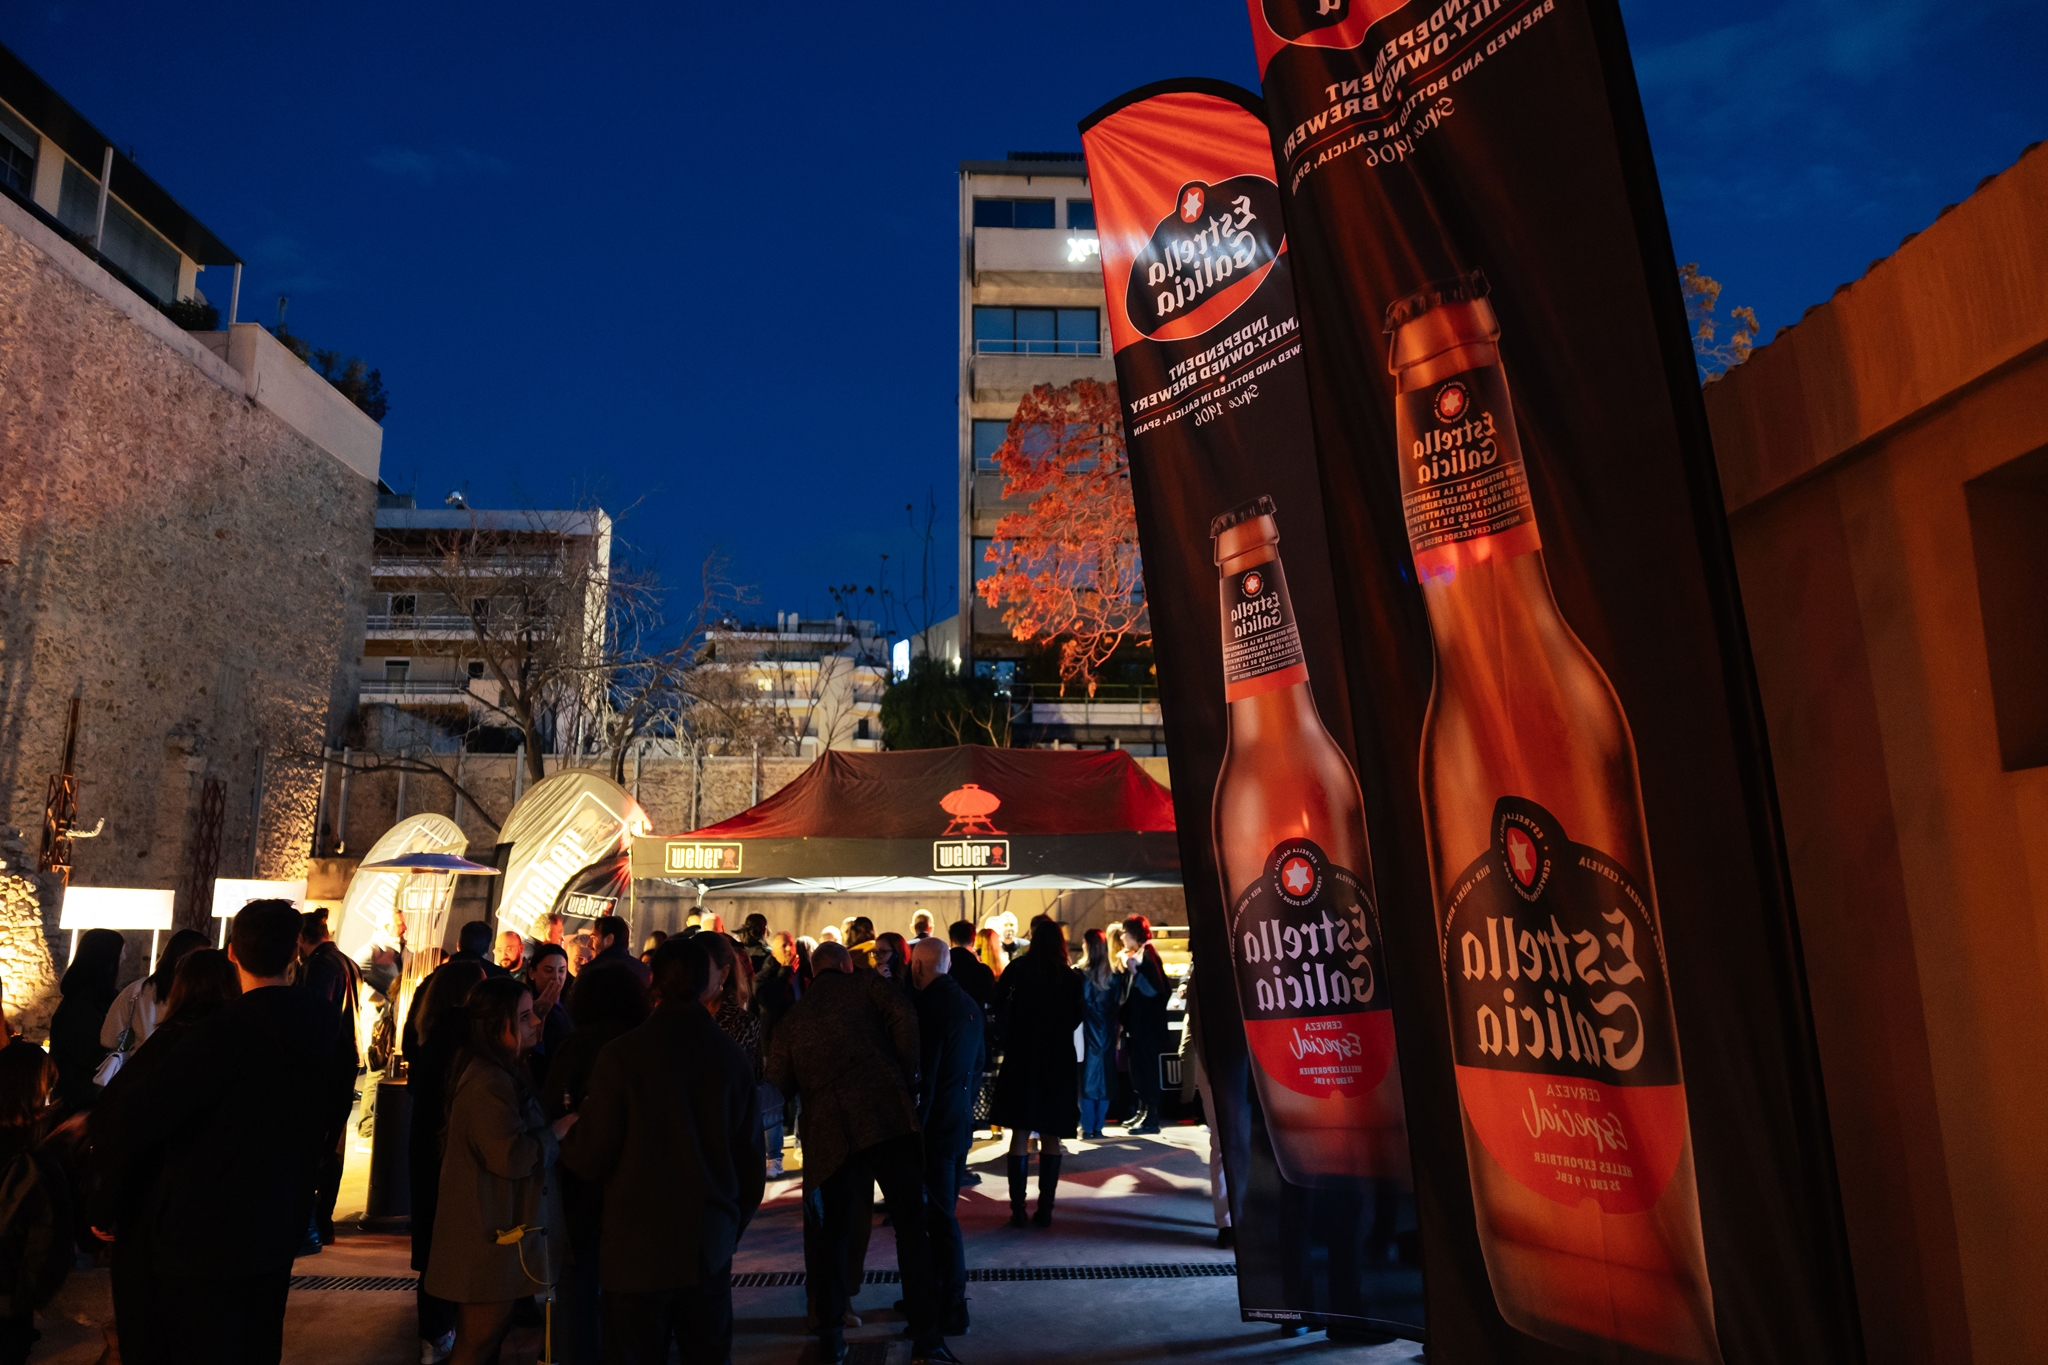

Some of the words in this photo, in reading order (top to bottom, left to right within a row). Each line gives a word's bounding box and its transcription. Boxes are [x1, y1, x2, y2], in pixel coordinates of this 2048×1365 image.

[671, 843, 723, 869] weber
[939, 841, 991, 867] weber
[509, 829, 591, 928] weber
[567, 895, 608, 918] weber
